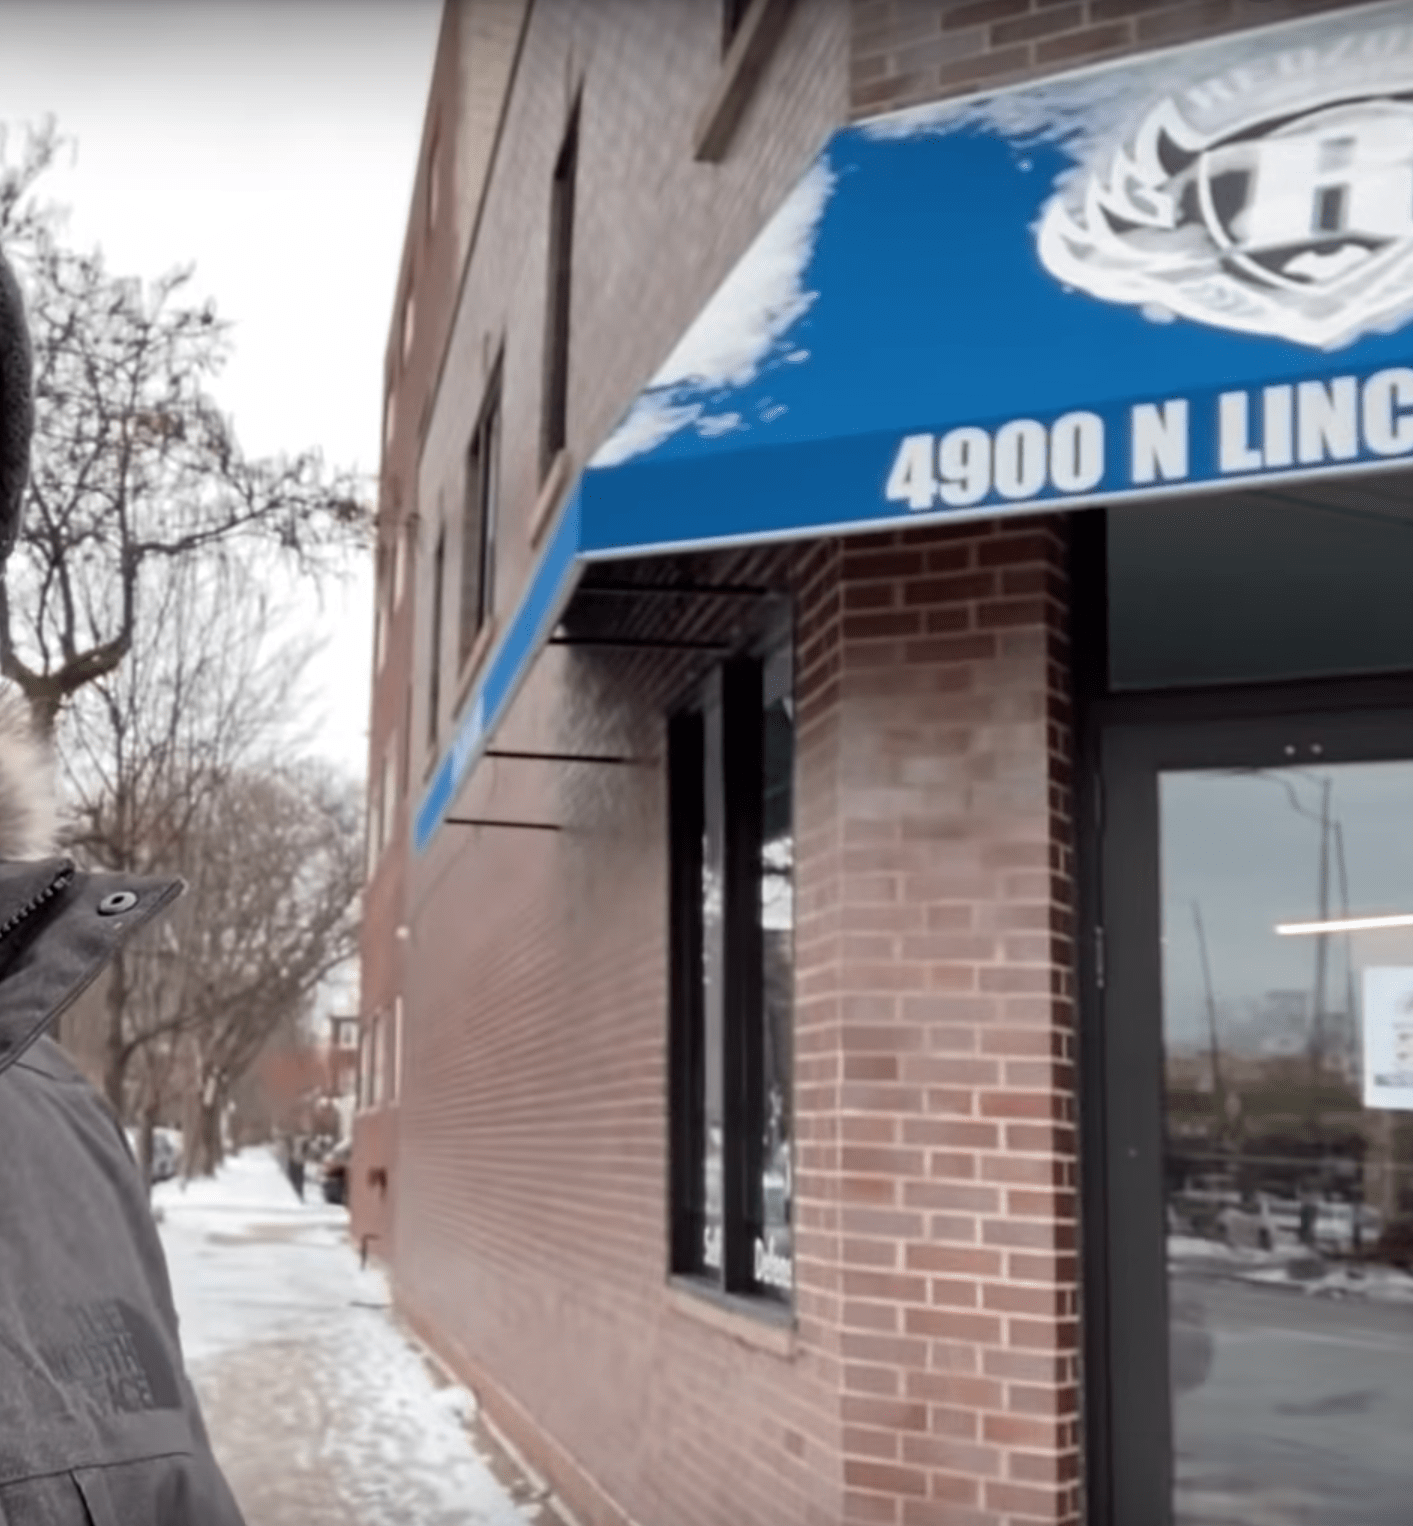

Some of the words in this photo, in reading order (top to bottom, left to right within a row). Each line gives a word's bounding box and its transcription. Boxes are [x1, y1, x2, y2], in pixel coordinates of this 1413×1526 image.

[887, 411, 1105, 510] 4900
[1131, 399, 1188, 483] N
[1219, 367, 1413, 472] LINC
